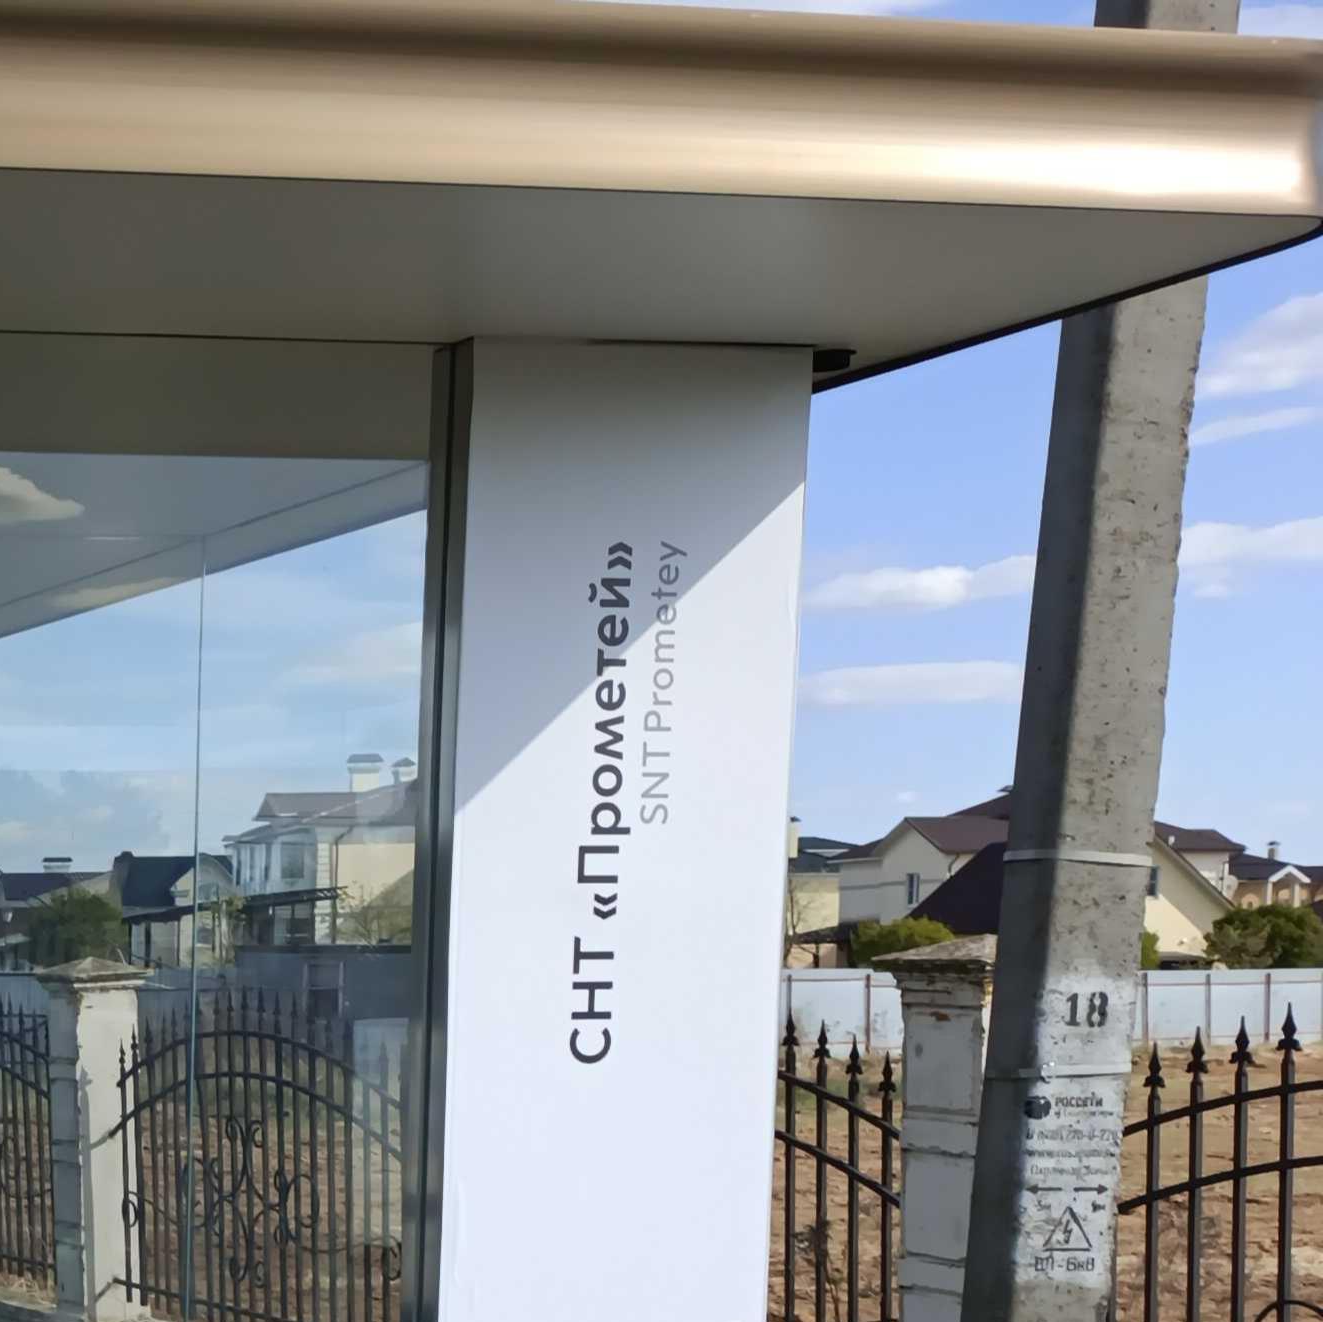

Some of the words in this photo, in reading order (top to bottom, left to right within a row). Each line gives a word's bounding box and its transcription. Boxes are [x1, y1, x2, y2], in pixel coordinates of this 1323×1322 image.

[643, 540, 688, 734] Prometey
[577, 541, 634, 920] «Прометей»
[640, 742, 670, 825] SNT
[569, 935, 615, 1064] СНТ
[1066, 991, 1109, 1028] 18
